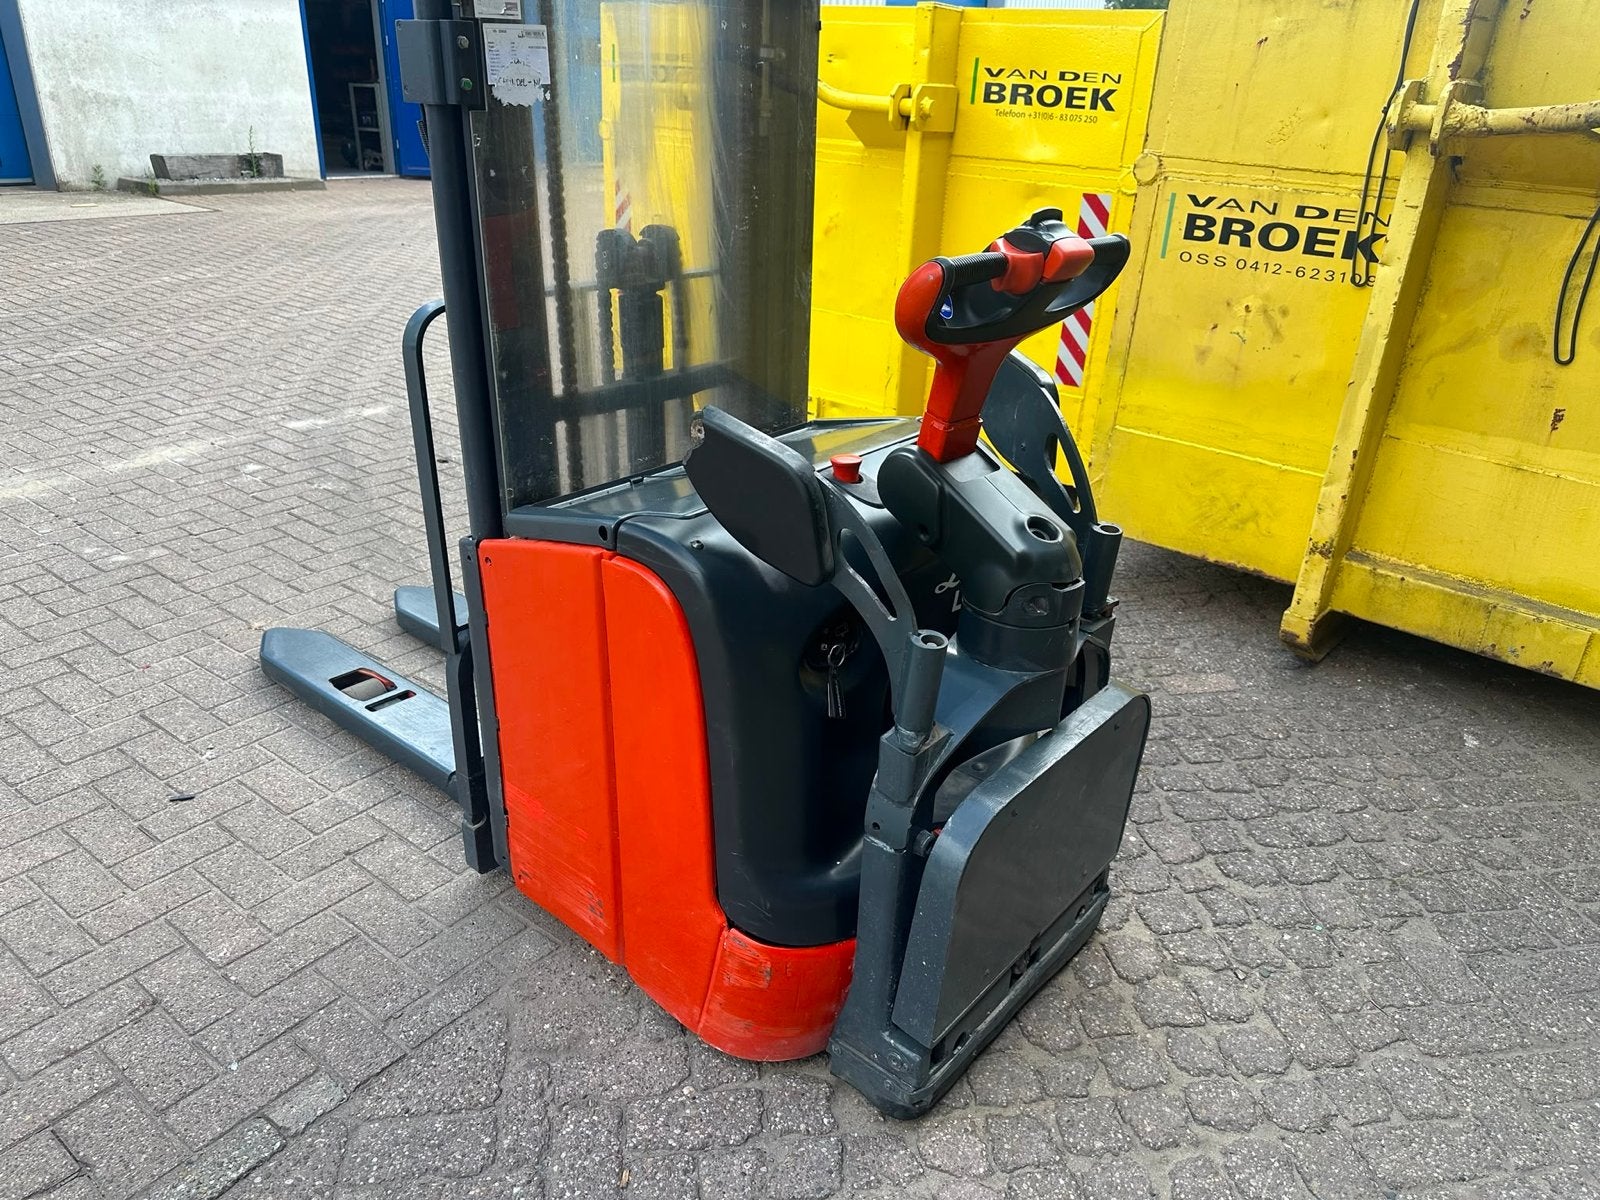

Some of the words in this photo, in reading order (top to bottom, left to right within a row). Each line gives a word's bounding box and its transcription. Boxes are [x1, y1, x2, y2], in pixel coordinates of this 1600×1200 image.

[984, 67, 1047, 81] VAN
[1058, 71, 1122, 84] DEN
[983, 82, 1118, 112] BROEK
[995, 108, 1026, 119] Telefoon
[1059, 114, 1068, 122] 83
[1069, 114, 1083, 123] 075
[1084, 115, 1098, 124] 250
[1187, 194, 1279, 216] VAN
[1294, 205, 1393, 228] DEN
[1183, 213, 1388, 263] BROEK
[1179, 251, 1227, 268] OSS
